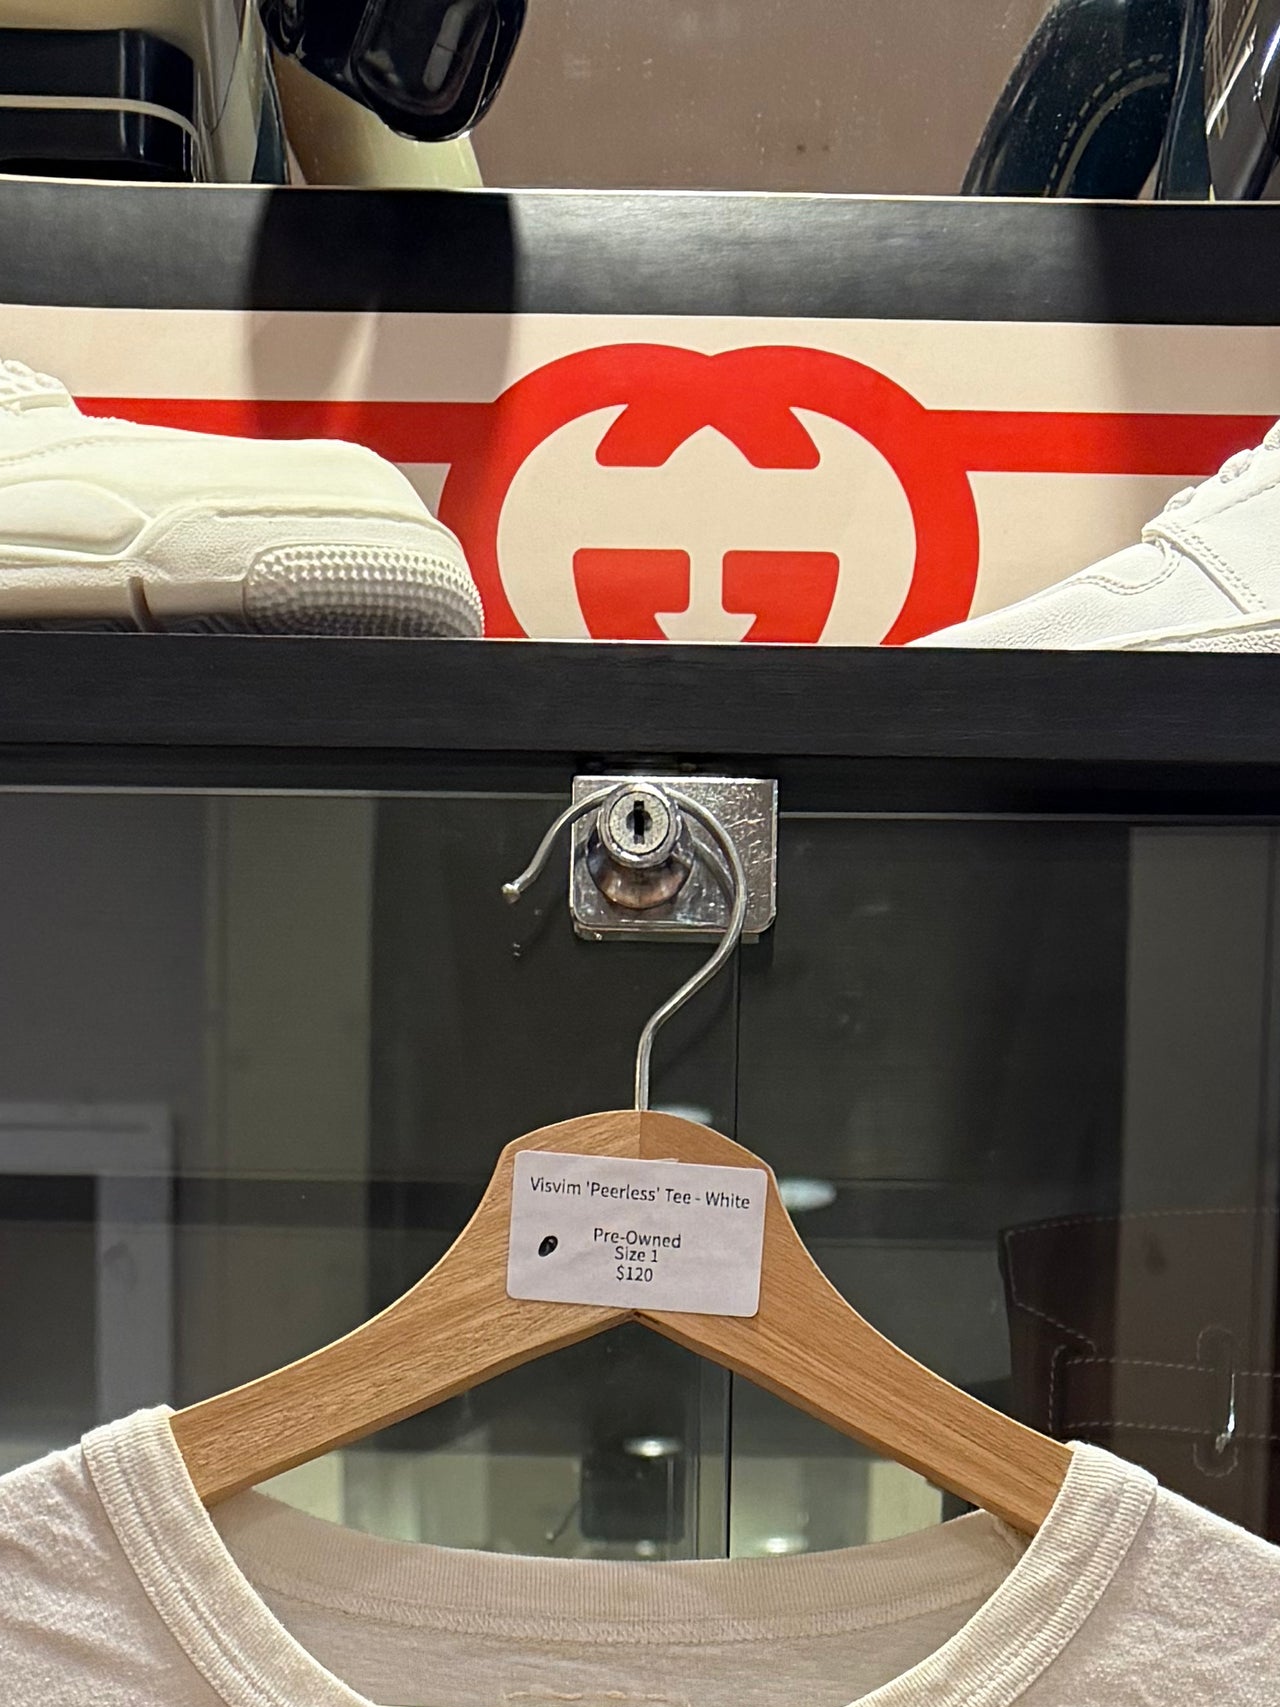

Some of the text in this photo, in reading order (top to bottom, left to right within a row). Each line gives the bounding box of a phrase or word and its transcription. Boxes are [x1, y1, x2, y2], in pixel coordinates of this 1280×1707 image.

[530, 1176, 582, 1196] Visvim
[586, 1180, 660, 1202] 'Peerless'
[665, 1188, 691, 1205] Tee
[705, 1191, 750, 1210] White
[594, 1227, 682, 1249] Pre-Owned
[614, 1245, 658, 1263] Size 1
[616, 1264, 653, 1282] $120
